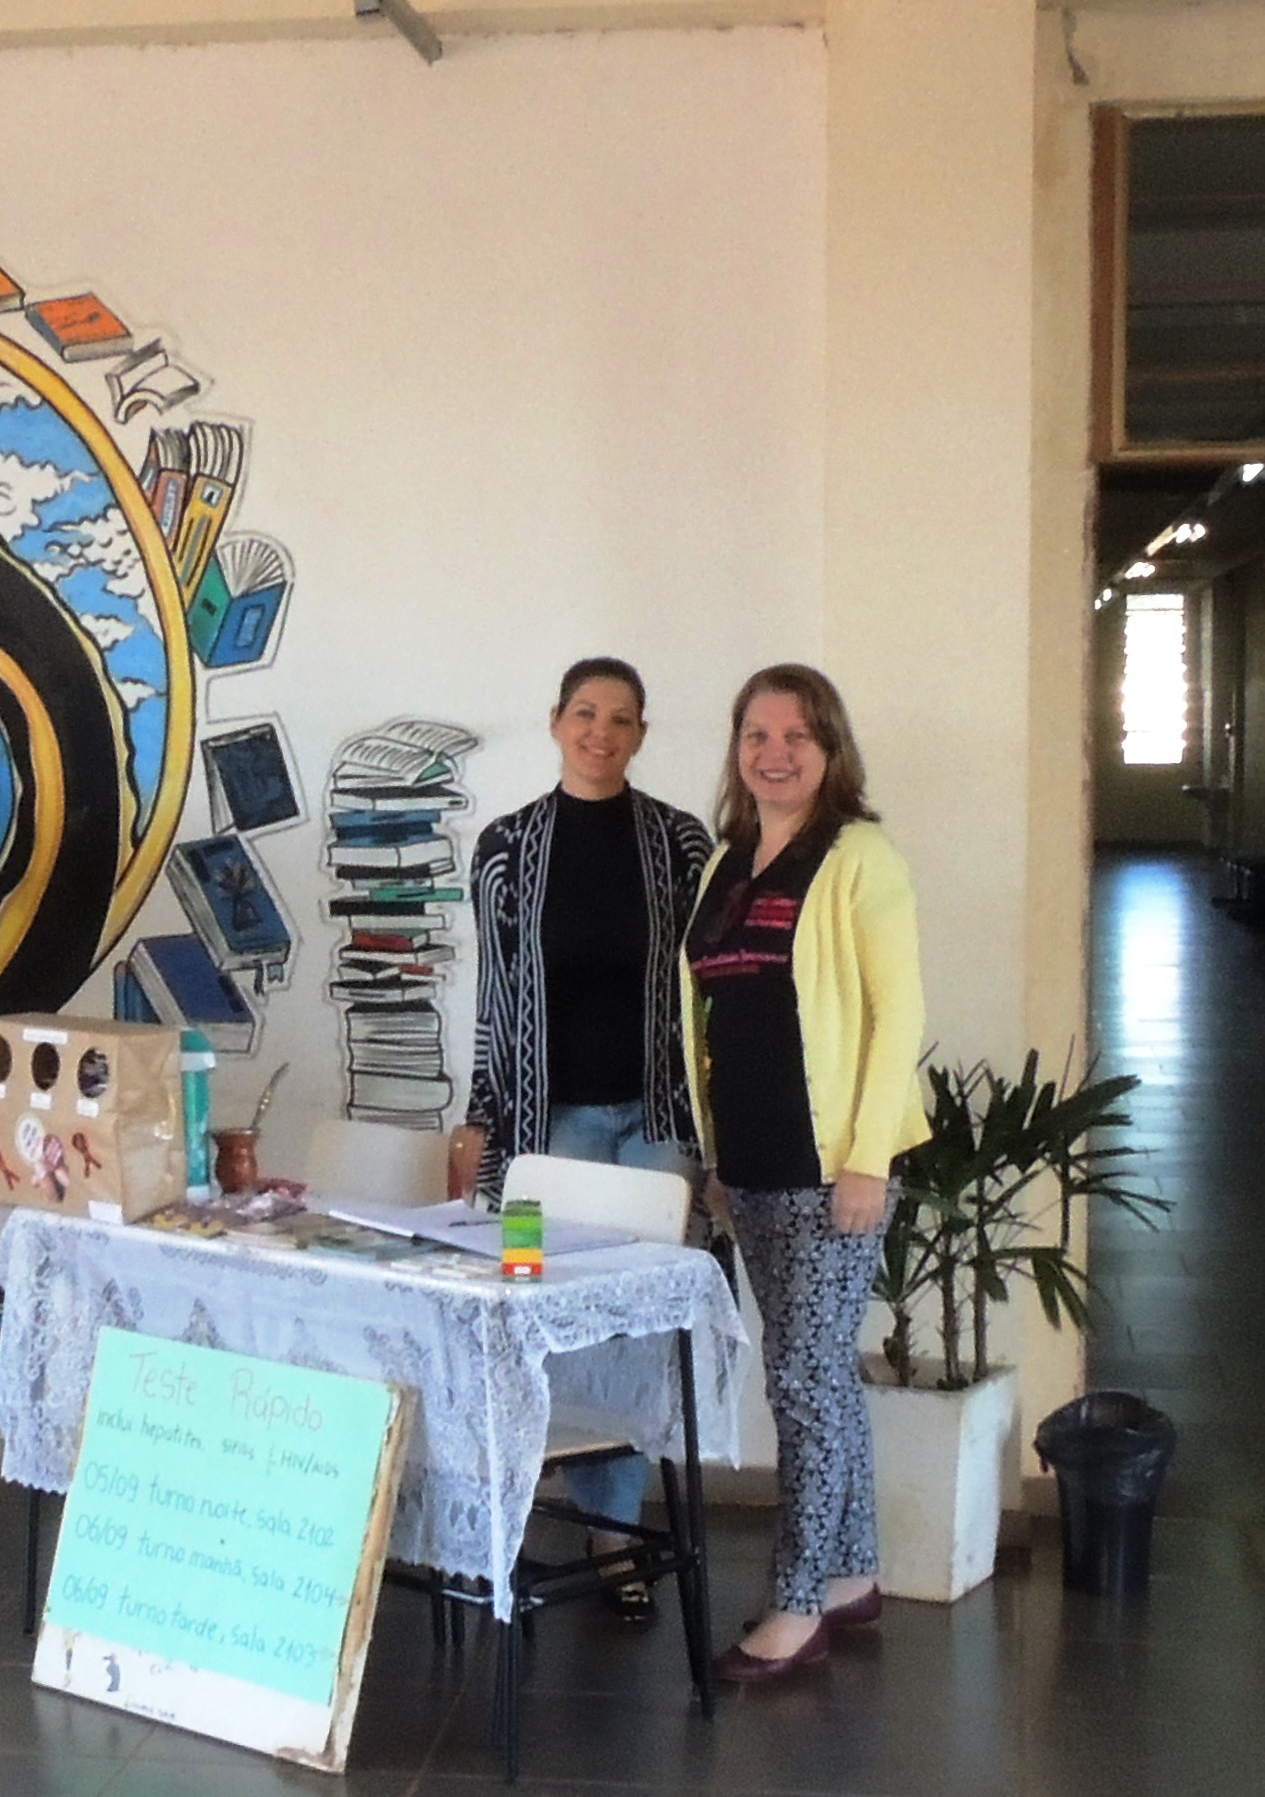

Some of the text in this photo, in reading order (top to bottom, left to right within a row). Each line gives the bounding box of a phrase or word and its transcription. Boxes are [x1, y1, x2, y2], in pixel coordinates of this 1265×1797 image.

[128, 1351, 323, 1433] Teste Rápido
[84, 1461, 140, 1503] 05/09
[149, 1474, 196, 1514] turno
[296, 1517, 335, 1547] 2102
[62, 1574, 109, 1610] 06/09
[117, 1585, 167, 1626] turno
[75, 1513, 128, 1551] 06/09
[137, 1529, 186, 1564] turno
[292, 1575, 337, 1608] 2104
